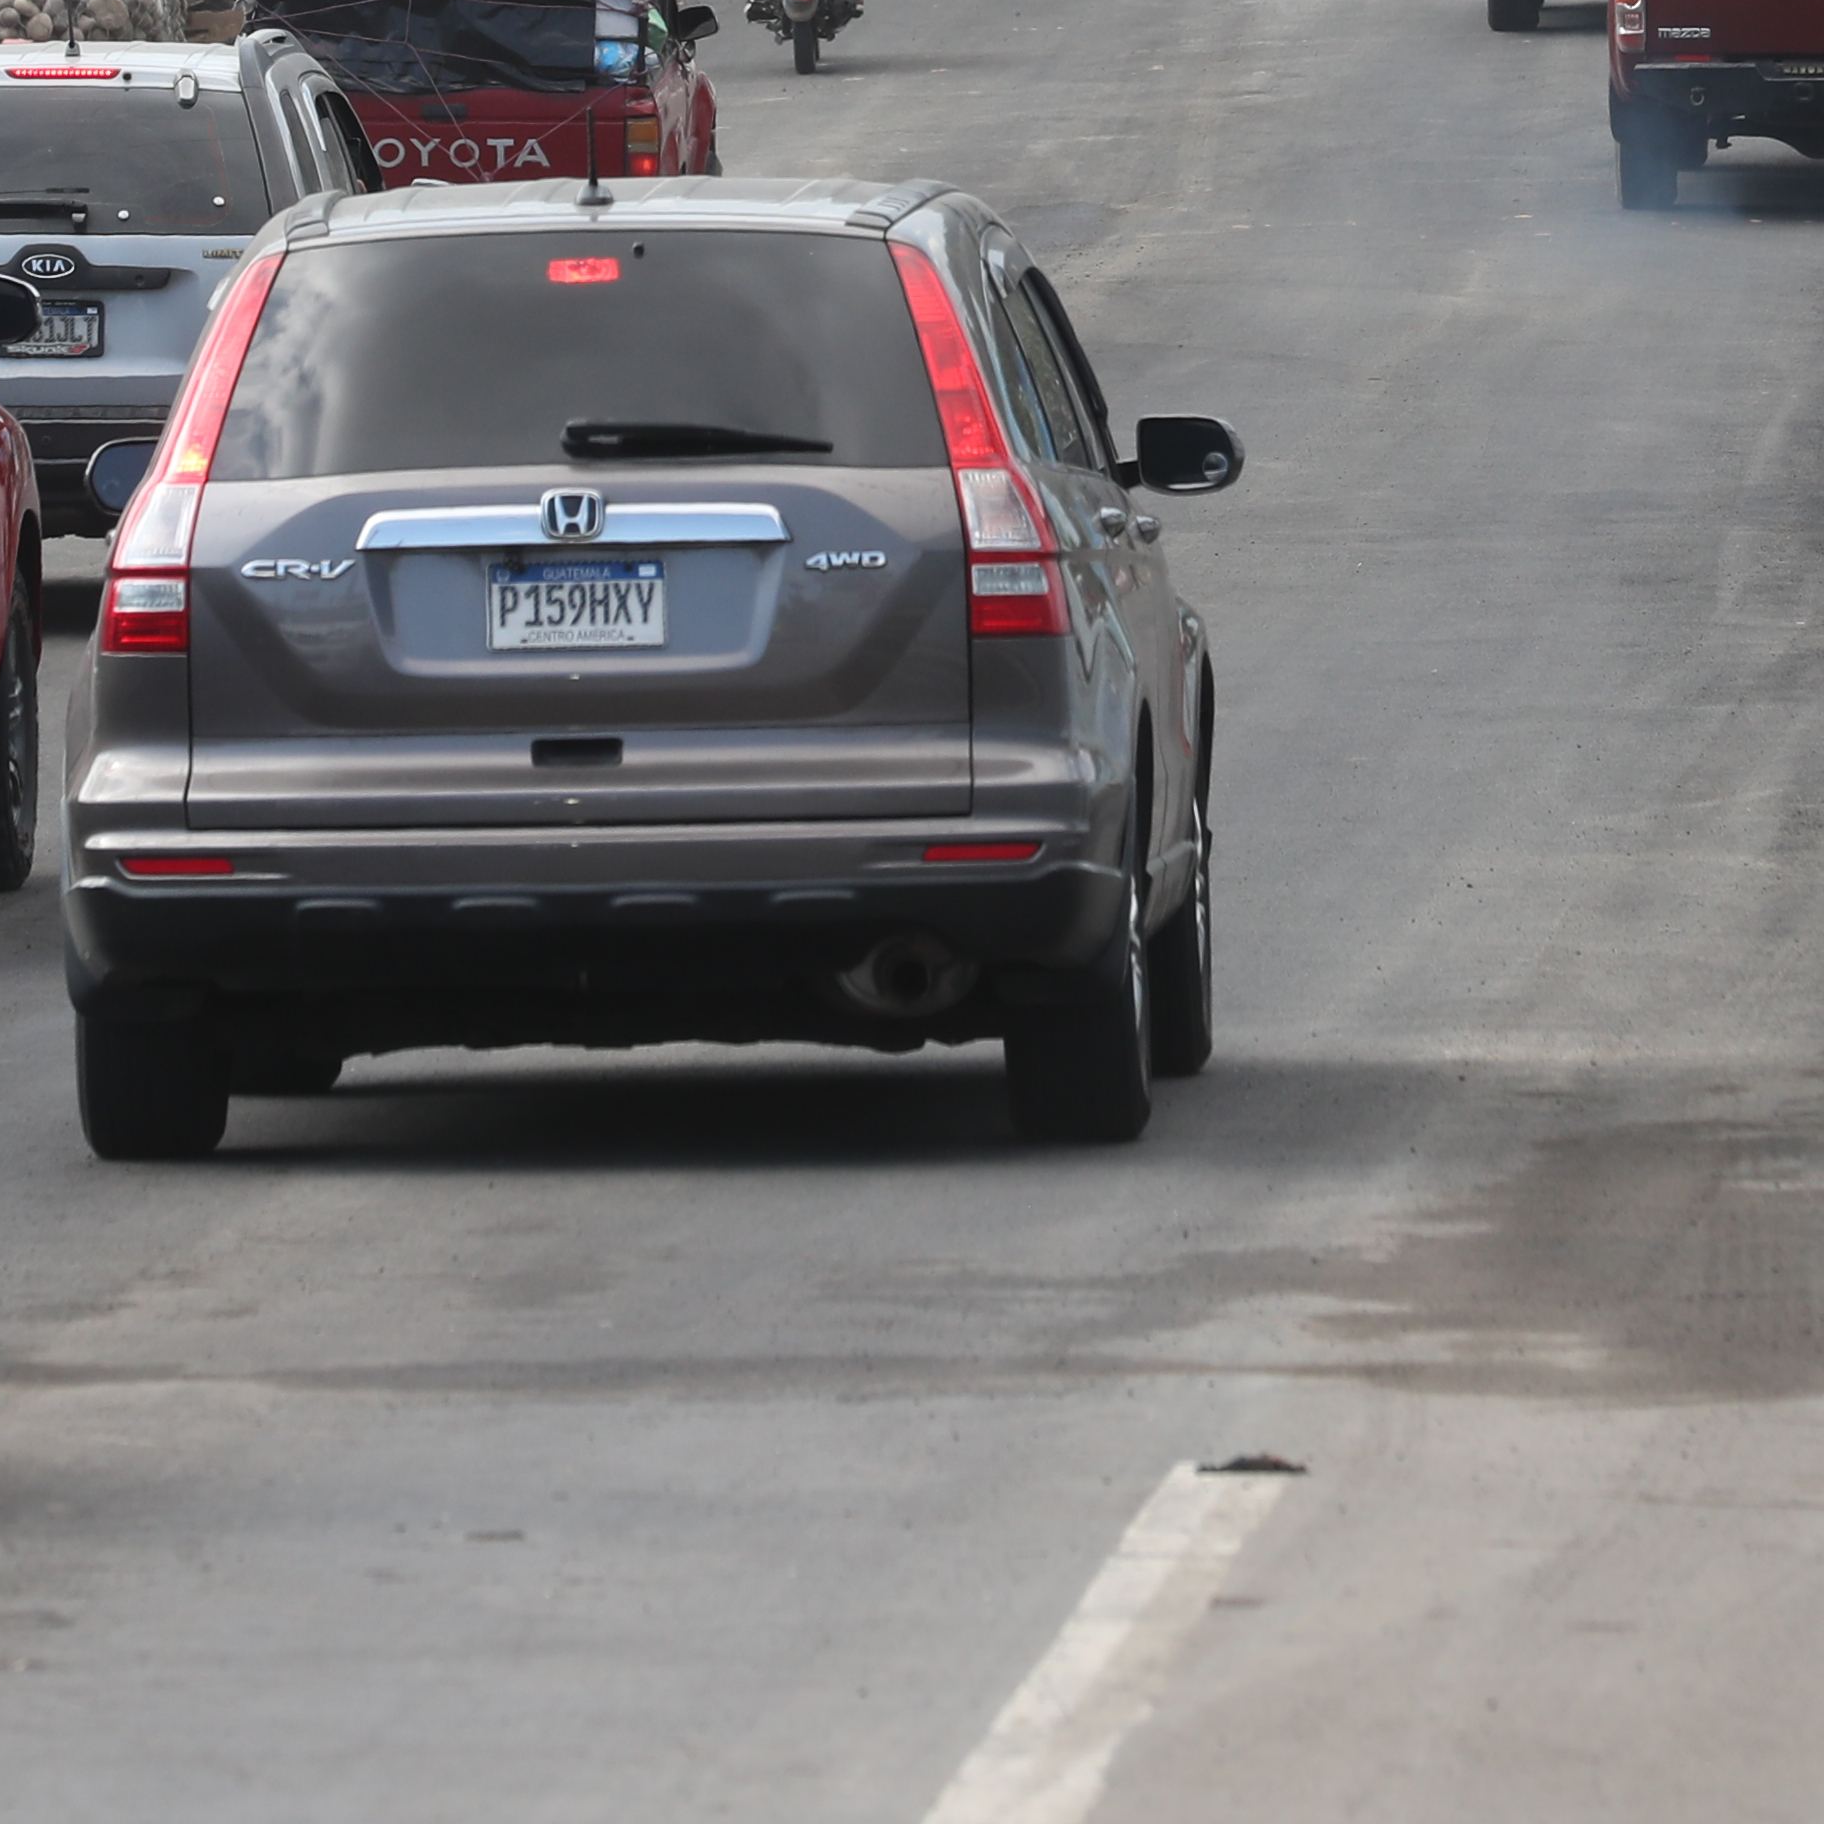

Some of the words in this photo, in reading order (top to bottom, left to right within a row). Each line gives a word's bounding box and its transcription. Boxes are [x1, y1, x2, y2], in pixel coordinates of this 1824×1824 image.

[1658, 27, 1711, 39] mazda
[374, 137, 551, 169] OYOTA
[31, 258, 66, 273] KIA
[804, 550, 887, 571] 4WD
[542, 567, 611, 580] GUATEMALA
[498, 581, 655, 628] P159HXY
[528, 630, 575, 644] CENTRO
